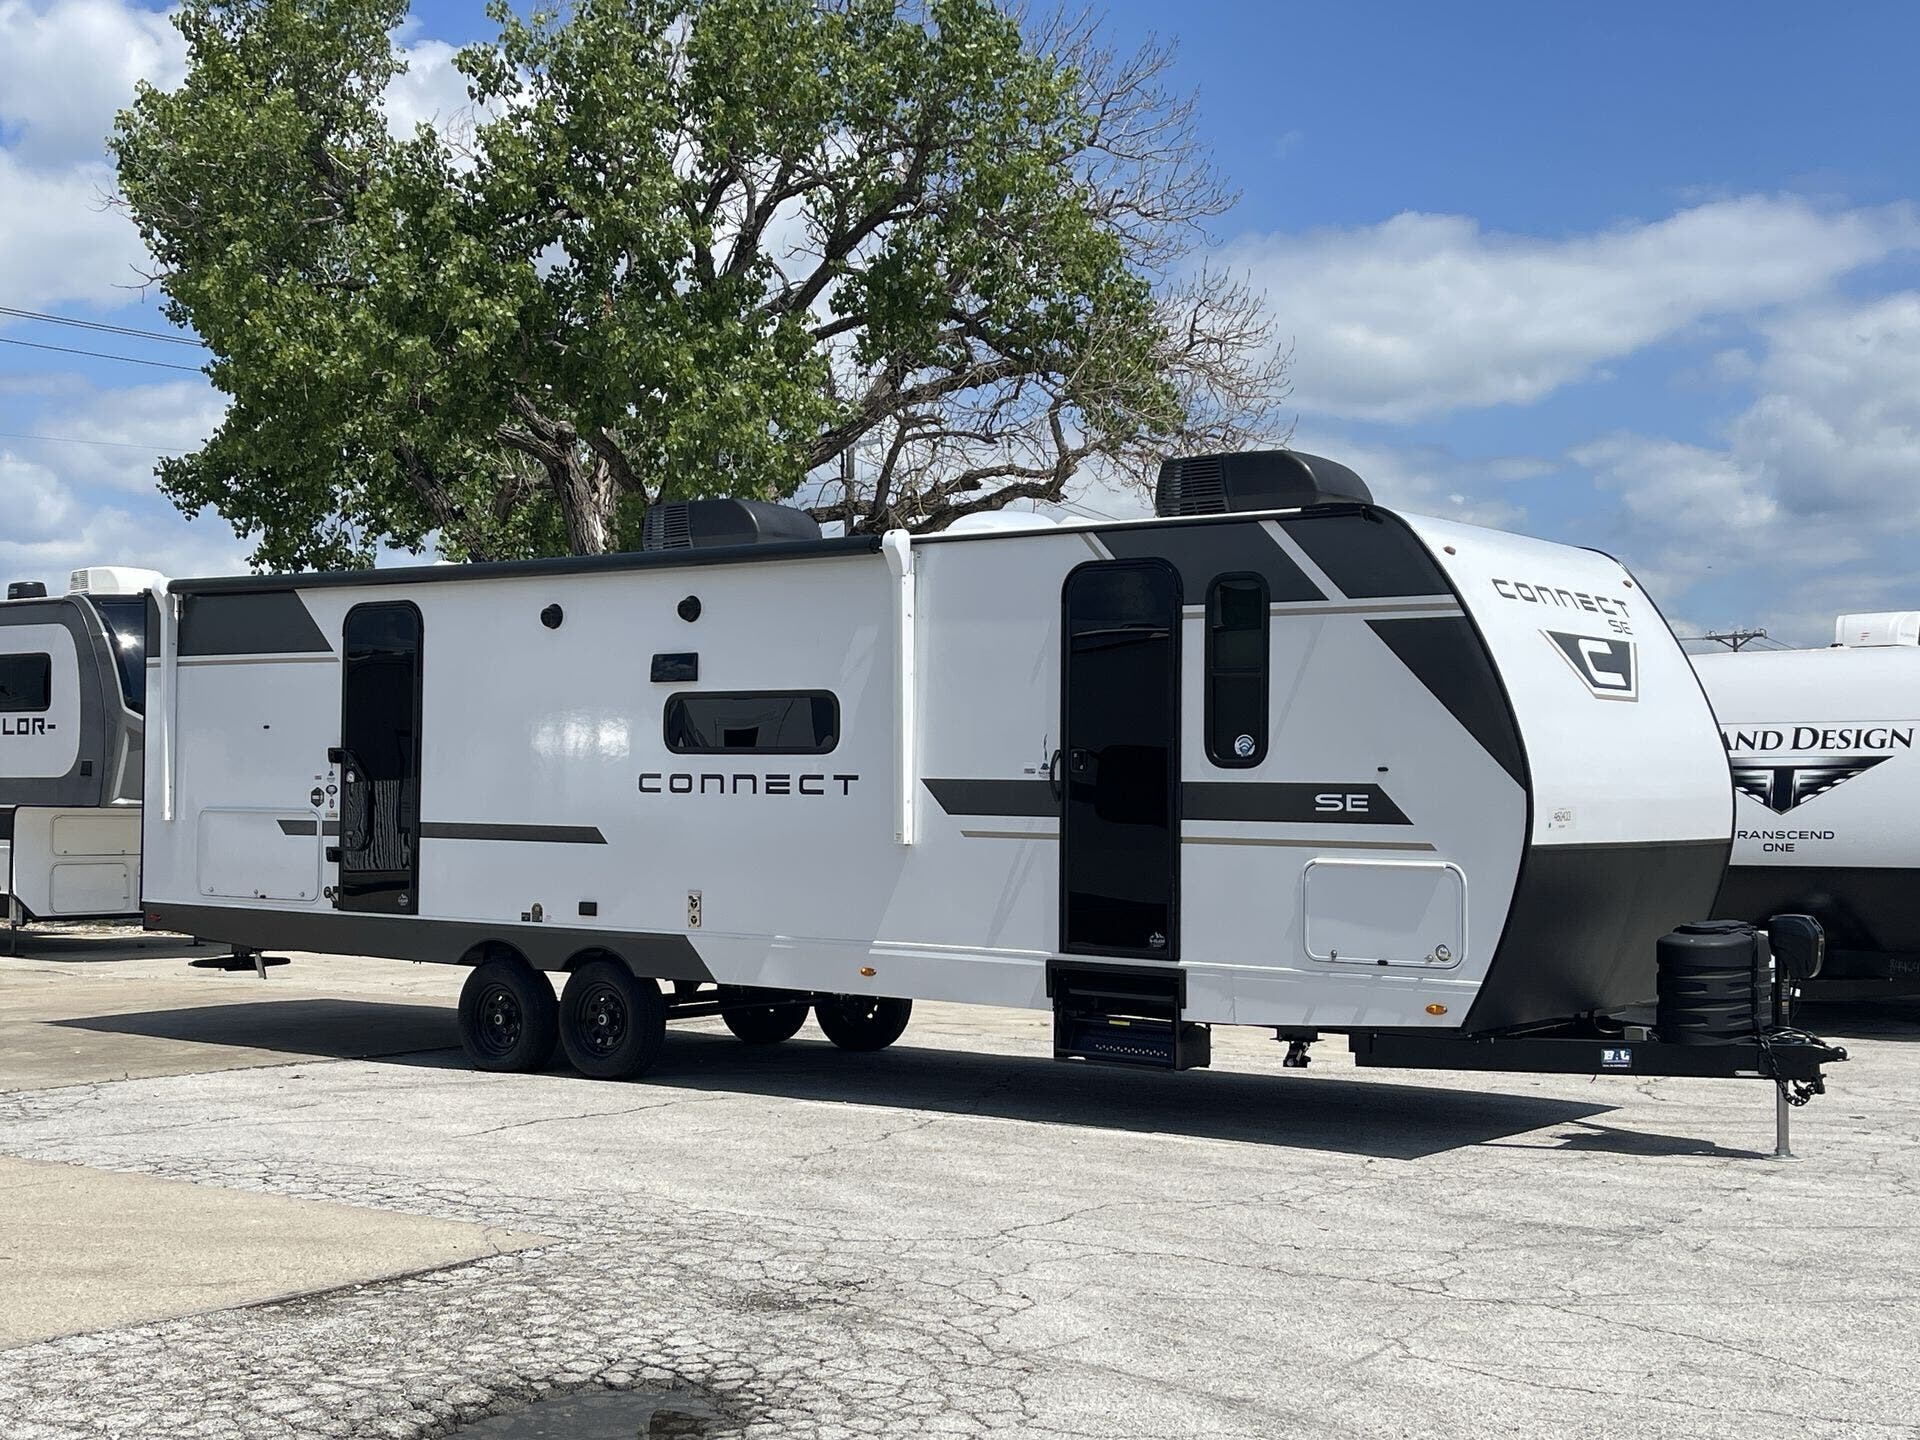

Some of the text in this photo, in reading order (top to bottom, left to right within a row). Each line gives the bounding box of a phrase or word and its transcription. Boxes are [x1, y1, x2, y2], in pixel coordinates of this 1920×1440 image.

[1491, 578, 1630, 618] CONNECT
[1608, 619, 1634, 635] SE
[1790, 726, 1916, 750] DESIGN
[638, 773, 859, 796] CONNECT
[1314, 793, 1369, 812] SE
[1733, 830, 1835, 840] RANSCEND
[1762, 843, 1795, 852] ONE
